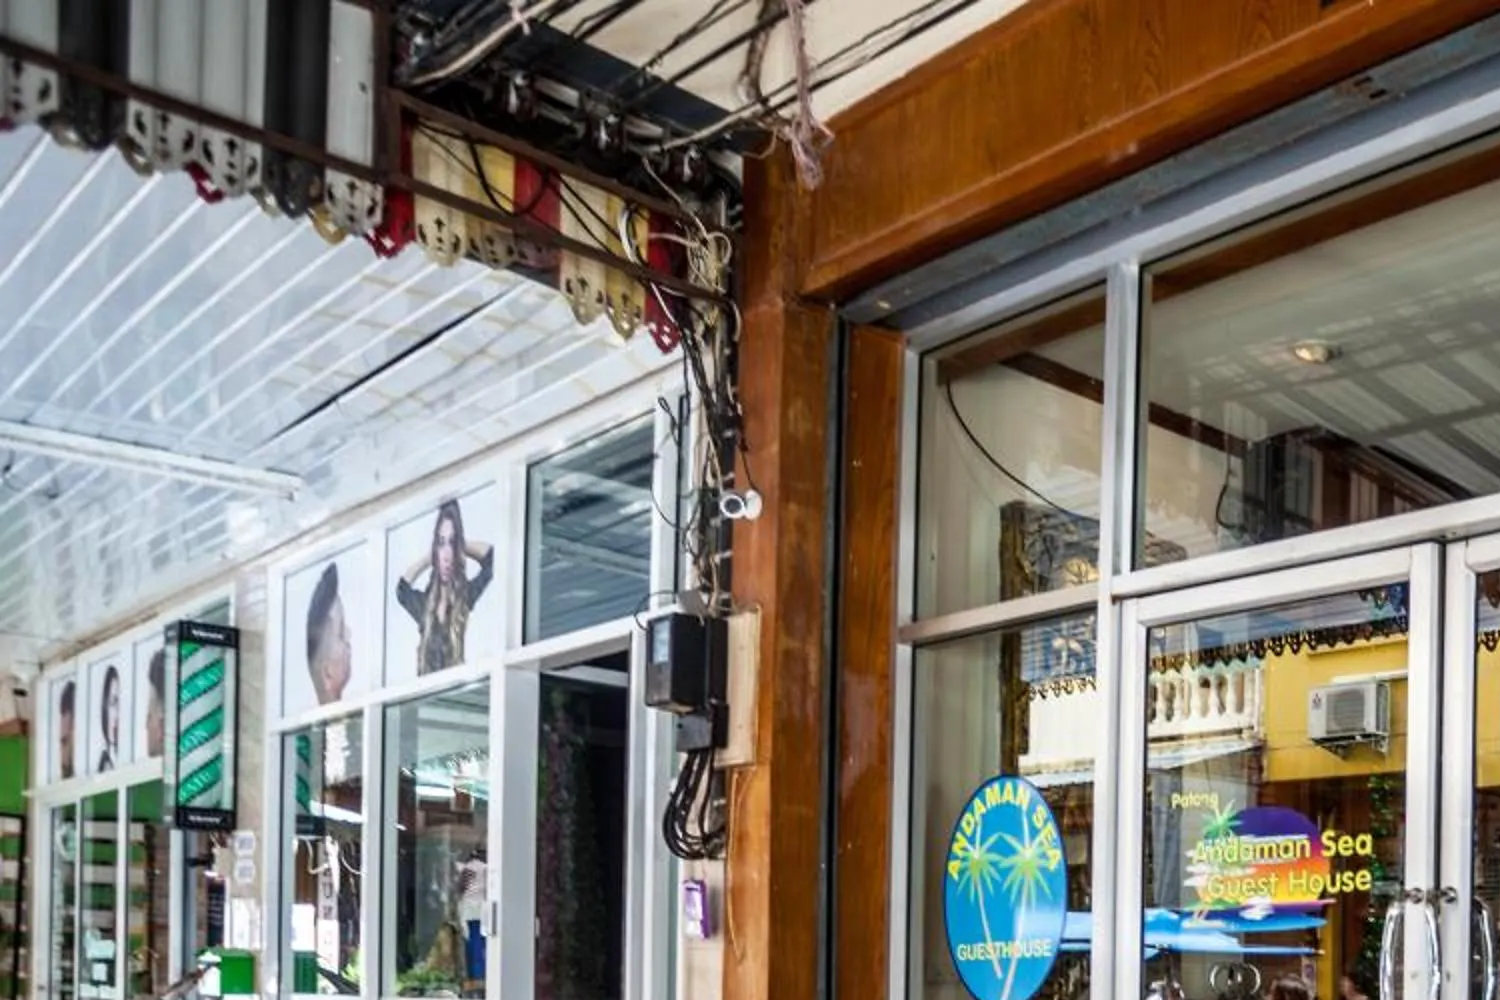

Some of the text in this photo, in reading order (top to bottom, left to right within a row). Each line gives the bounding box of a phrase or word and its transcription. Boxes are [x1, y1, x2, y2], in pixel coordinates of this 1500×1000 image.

[1171, 791, 1220, 810] Patong
[947, 781, 1062, 881] ANDAMAN SEA
[1193, 829, 1374, 865] Andaman Sea
[1207, 868, 1373, 899] Guest House
[956, 938, 1053, 962] GUESTHOUSE
